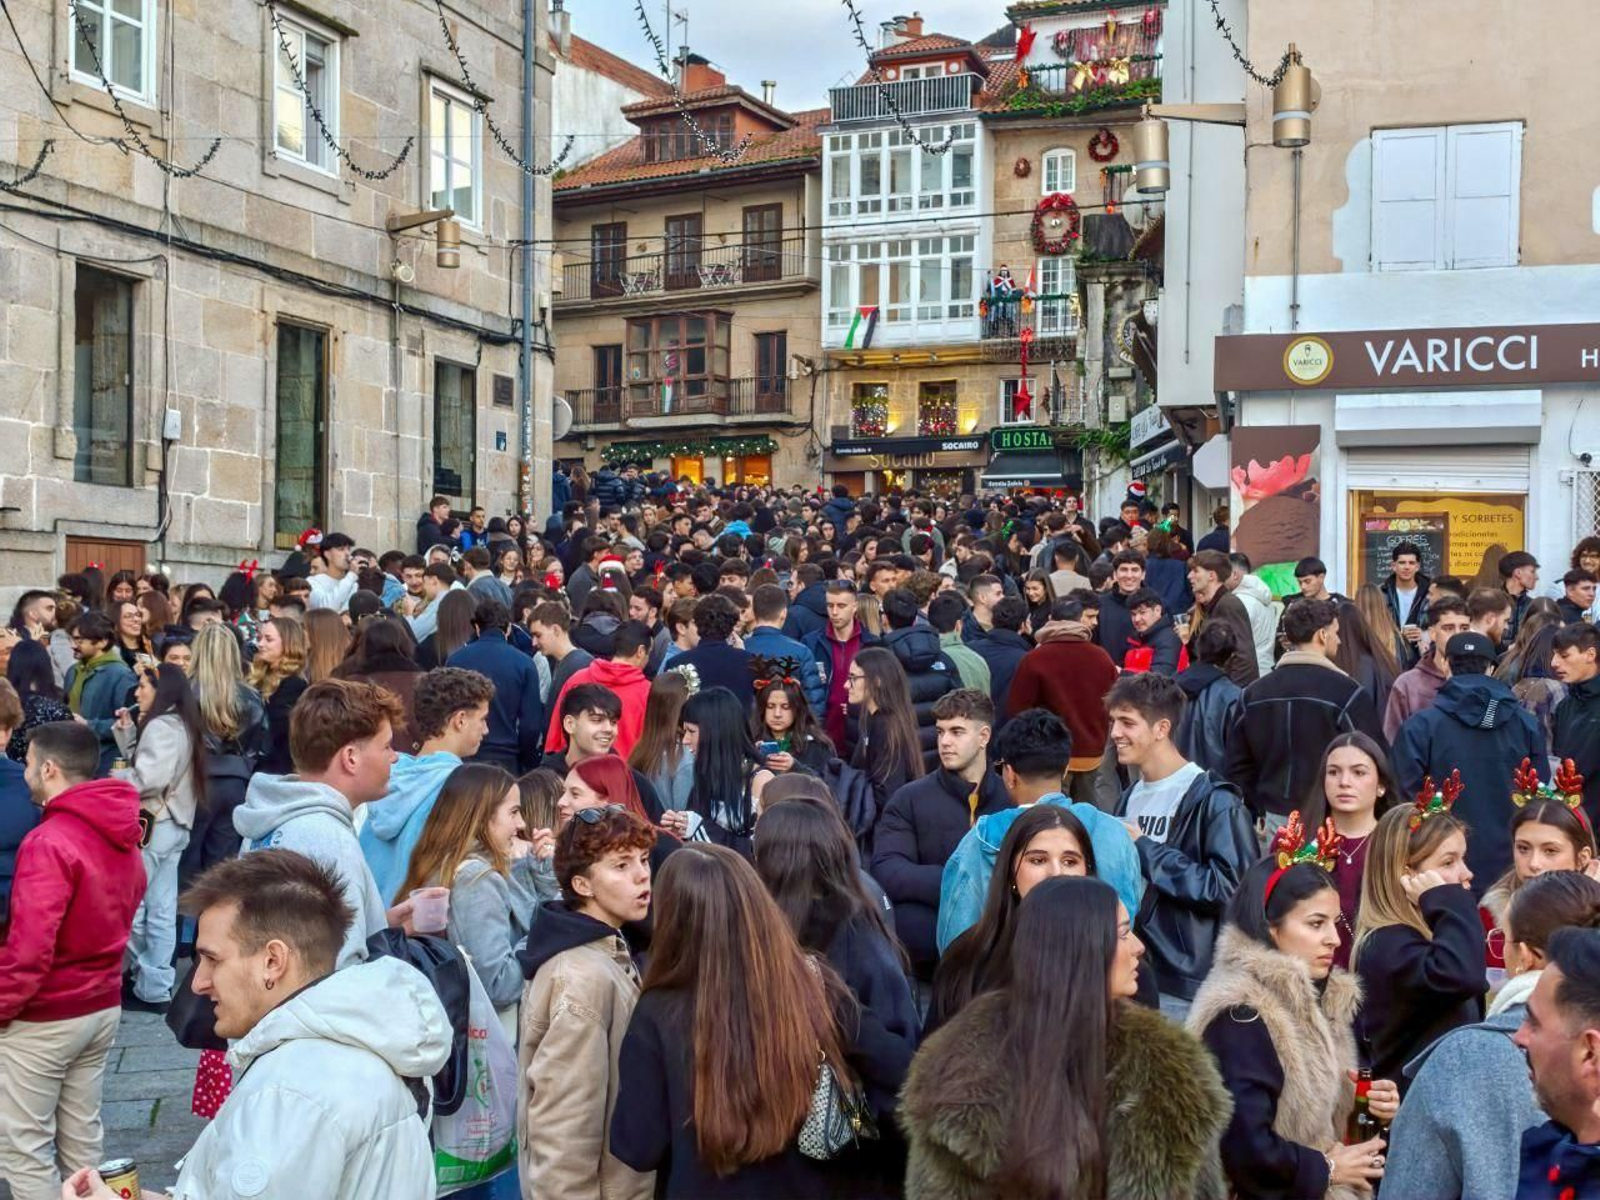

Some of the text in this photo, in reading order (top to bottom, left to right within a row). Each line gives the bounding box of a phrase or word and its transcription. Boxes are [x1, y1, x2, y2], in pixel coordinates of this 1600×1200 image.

[1364, 335, 1538, 377] VARICCI
[1293, 358, 1322, 366] VARICCI
[942, 441, 979, 450] SOCAIRO
[1462, 513, 1514, 523] SORBETES
[1138, 815, 1172, 837] HIO
